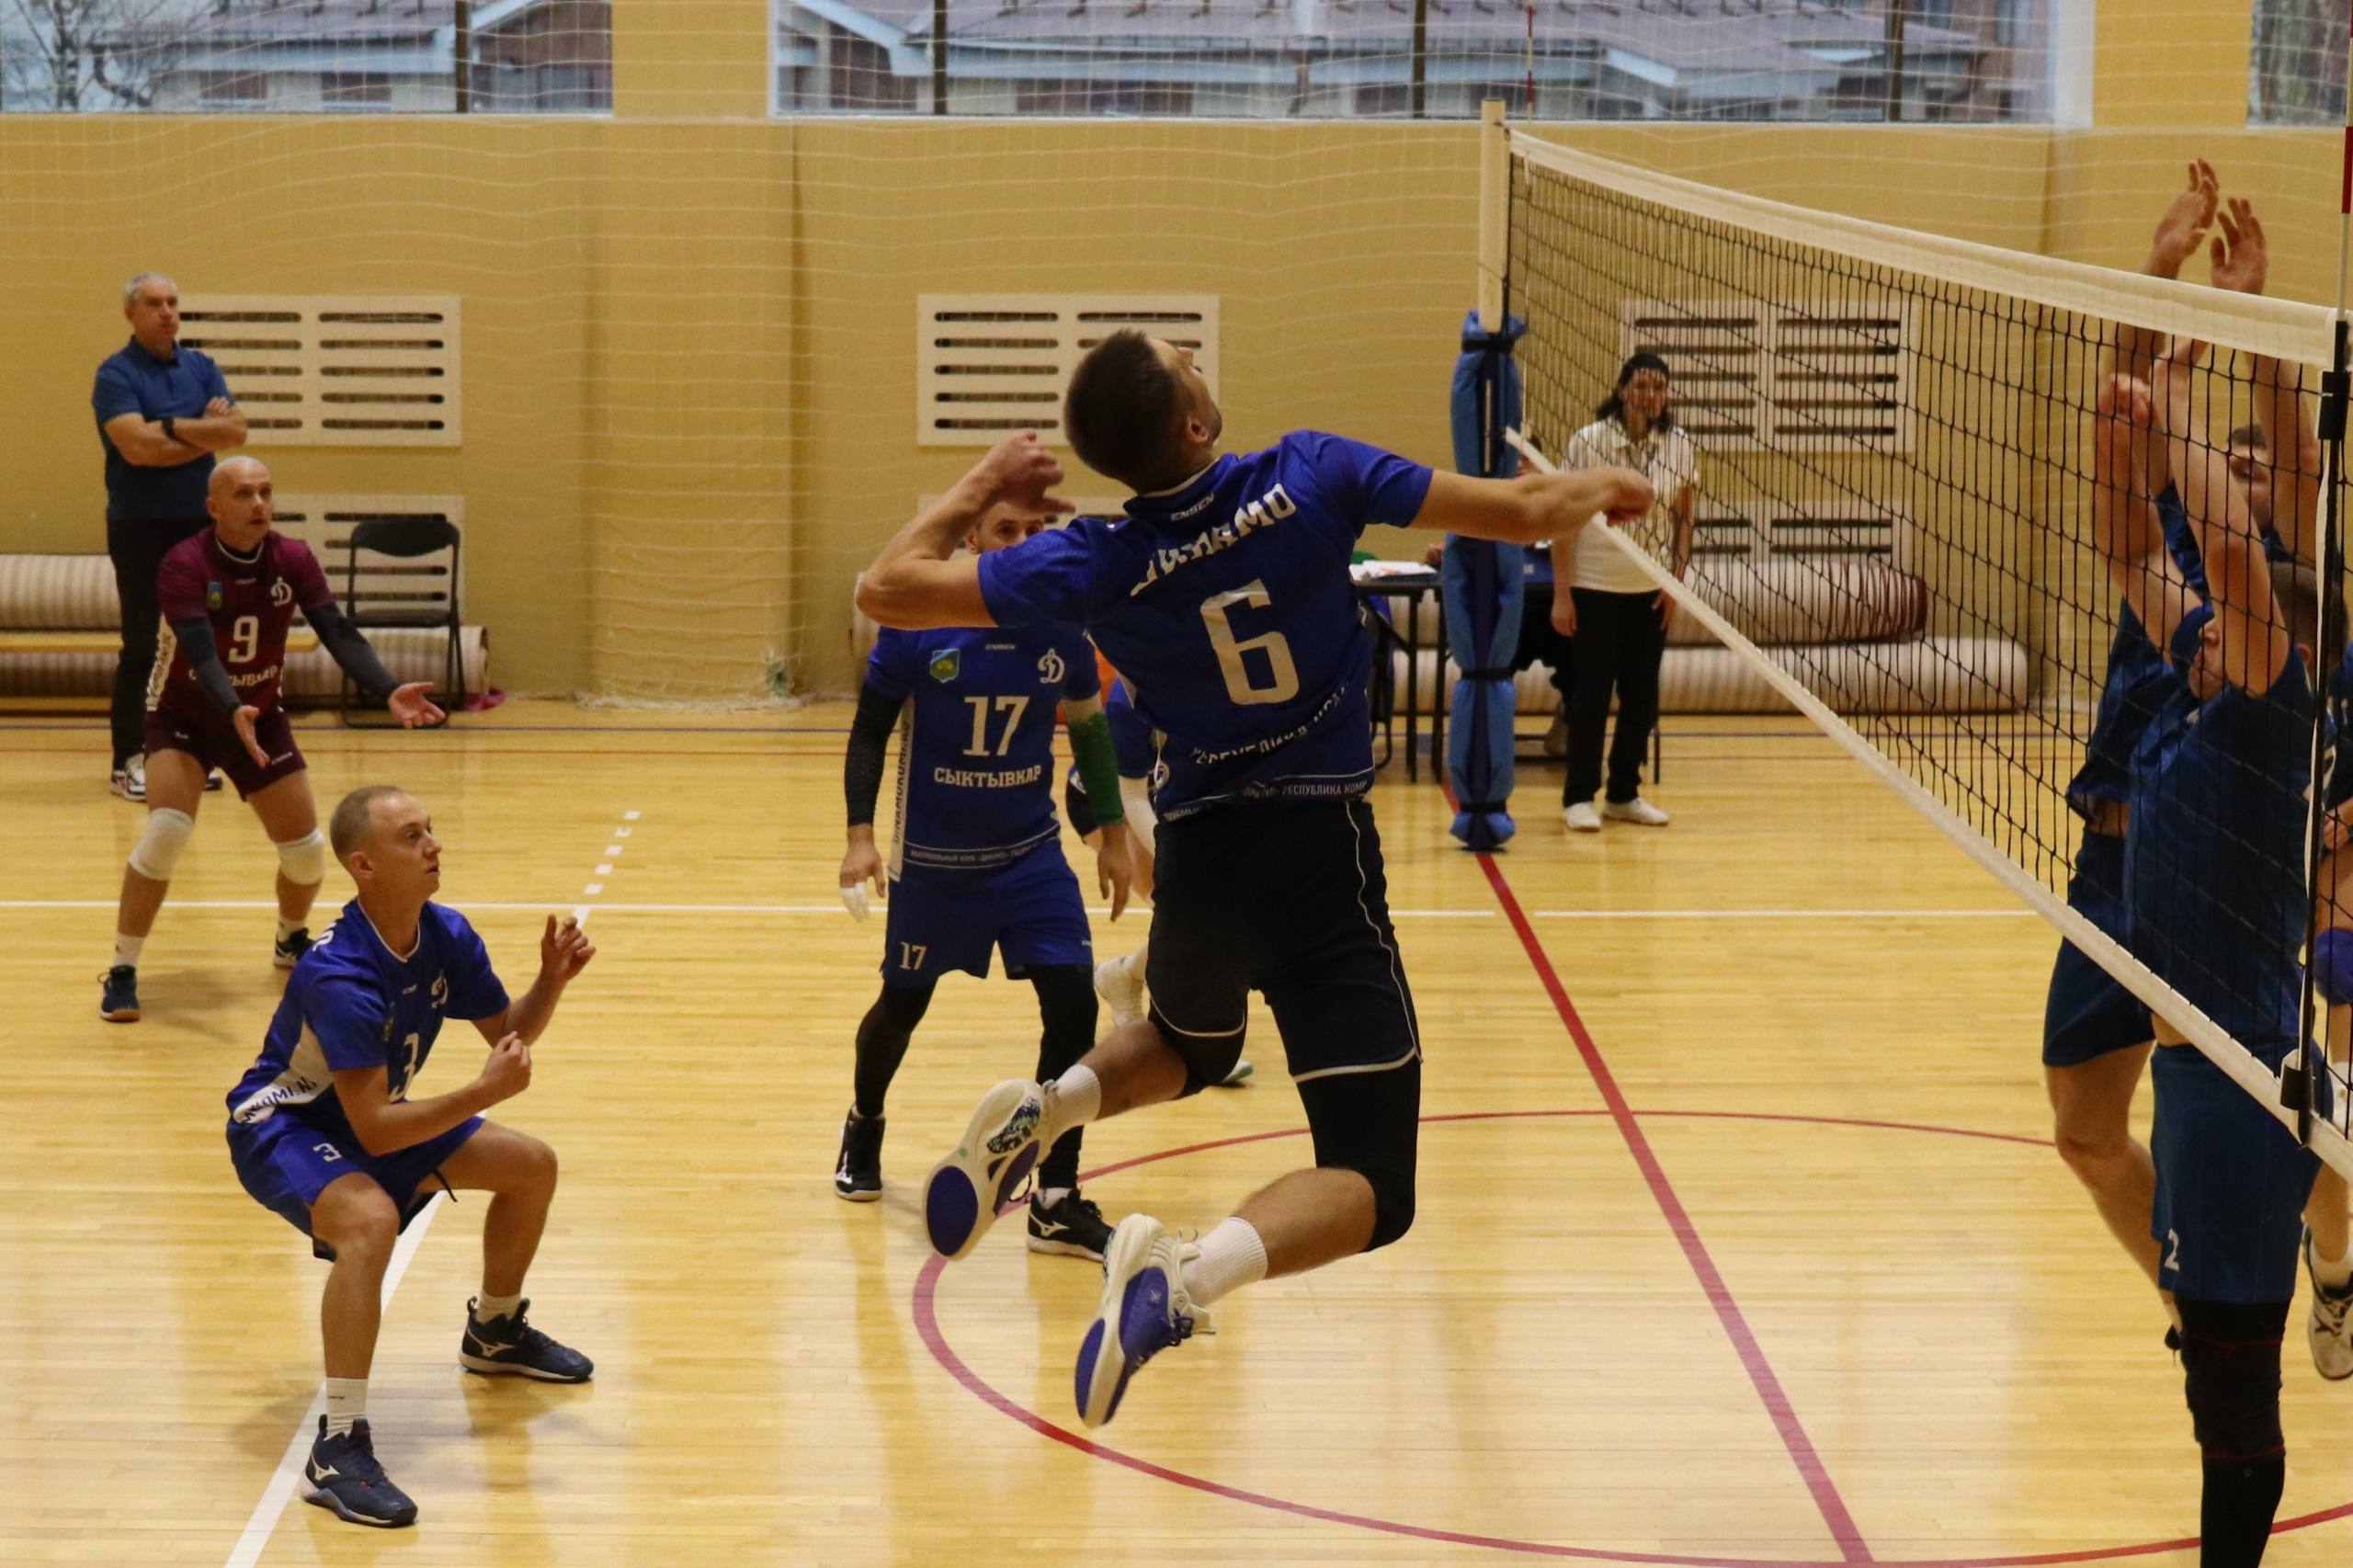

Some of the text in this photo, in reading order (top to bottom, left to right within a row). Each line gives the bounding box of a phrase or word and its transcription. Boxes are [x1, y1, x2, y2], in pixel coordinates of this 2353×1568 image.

[228, 615, 259, 664] 9
[1199, 578, 1300, 705] 6
[963, 696, 1030, 756] 17
[934, 765, 1042, 789] СЫКТЫВКАР
[899, 941, 927, 971] 17
[313, 1142, 343, 1163] 3
[2164, 1228, 2180, 1273] 2
